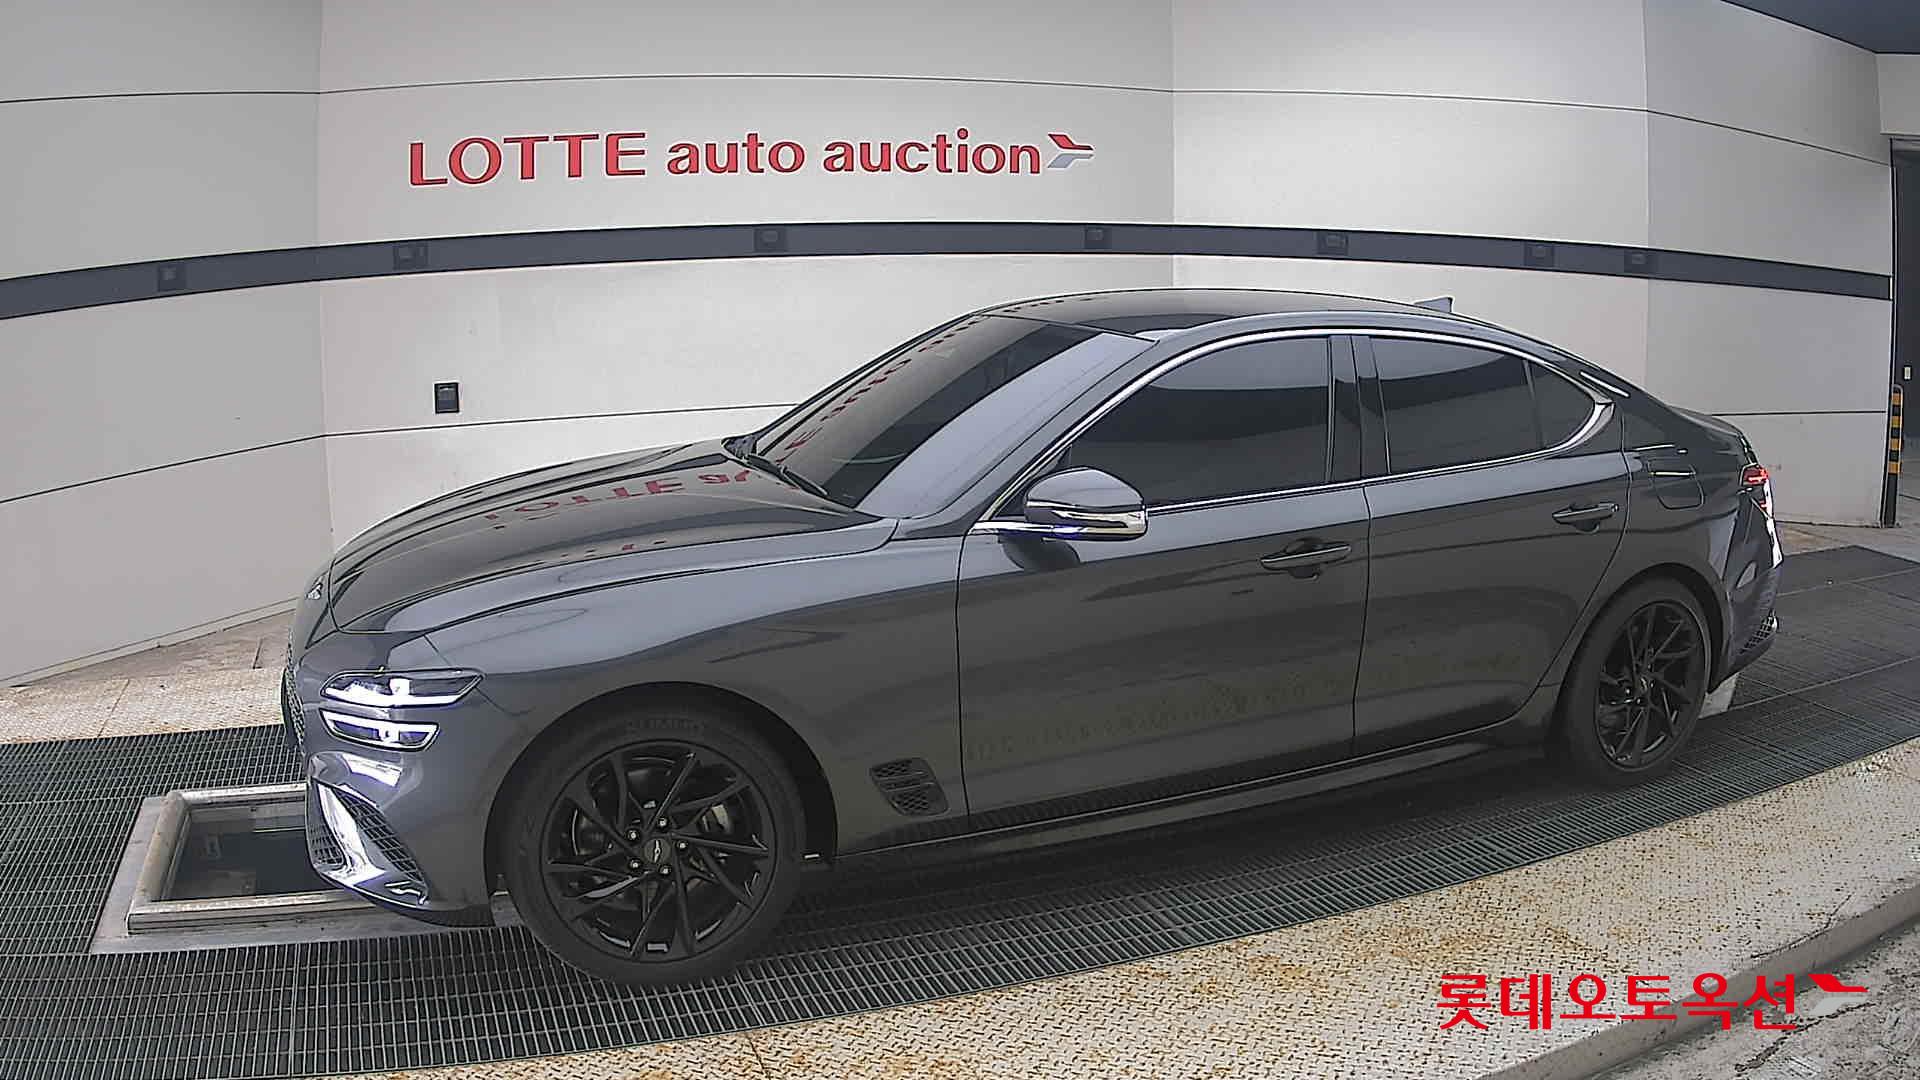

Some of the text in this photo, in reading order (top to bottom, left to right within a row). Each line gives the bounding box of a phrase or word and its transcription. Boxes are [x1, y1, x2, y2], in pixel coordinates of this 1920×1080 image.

[409, 127, 1041, 186] LOTTE auto auction
